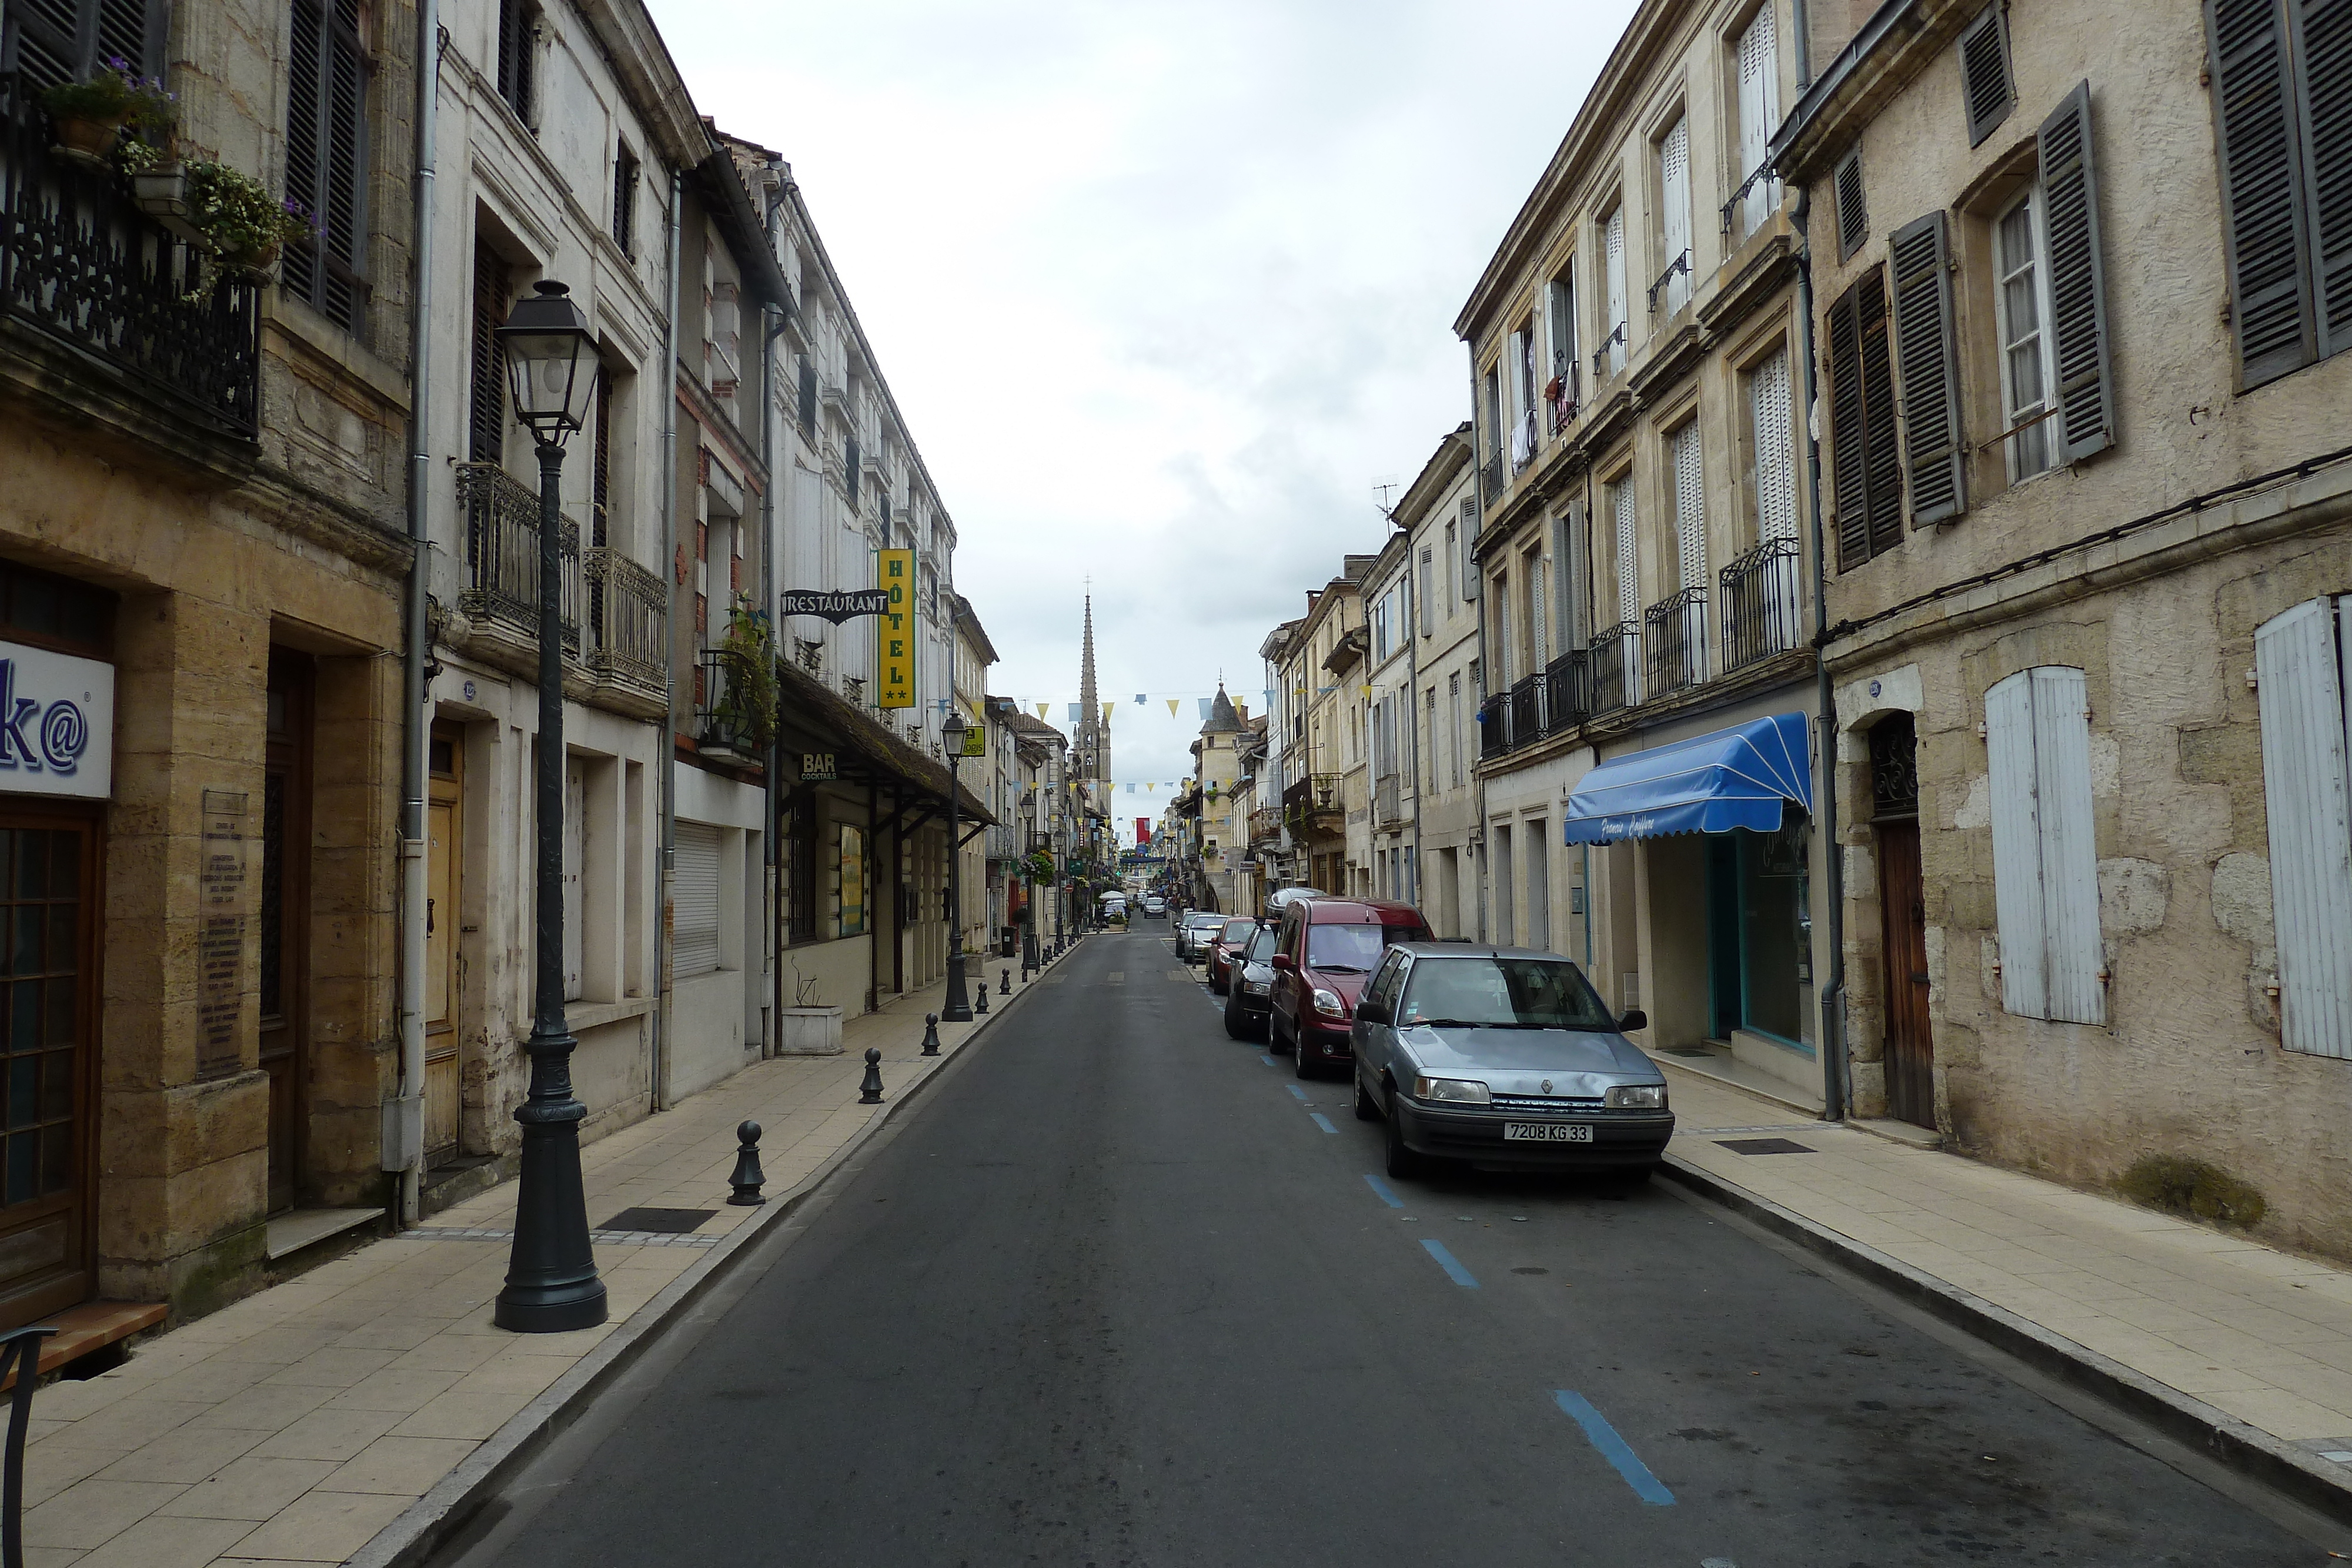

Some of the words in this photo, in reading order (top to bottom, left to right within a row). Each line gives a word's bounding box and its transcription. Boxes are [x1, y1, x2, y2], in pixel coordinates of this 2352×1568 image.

[787, 595, 887, 612] RESTAURANT
[888, 560, 903, 684] HÔTEL
[803, 753, 836, 773] BAR
[1601, 817, 1623, 838] Francis
[1628, 814, 1654, 837] Coiffure
[1511, 1124, 1546, 1139] 7208
[1549, 1125, 1567, 1140] KG
[1570, 1126, 1587, 1141] 33
